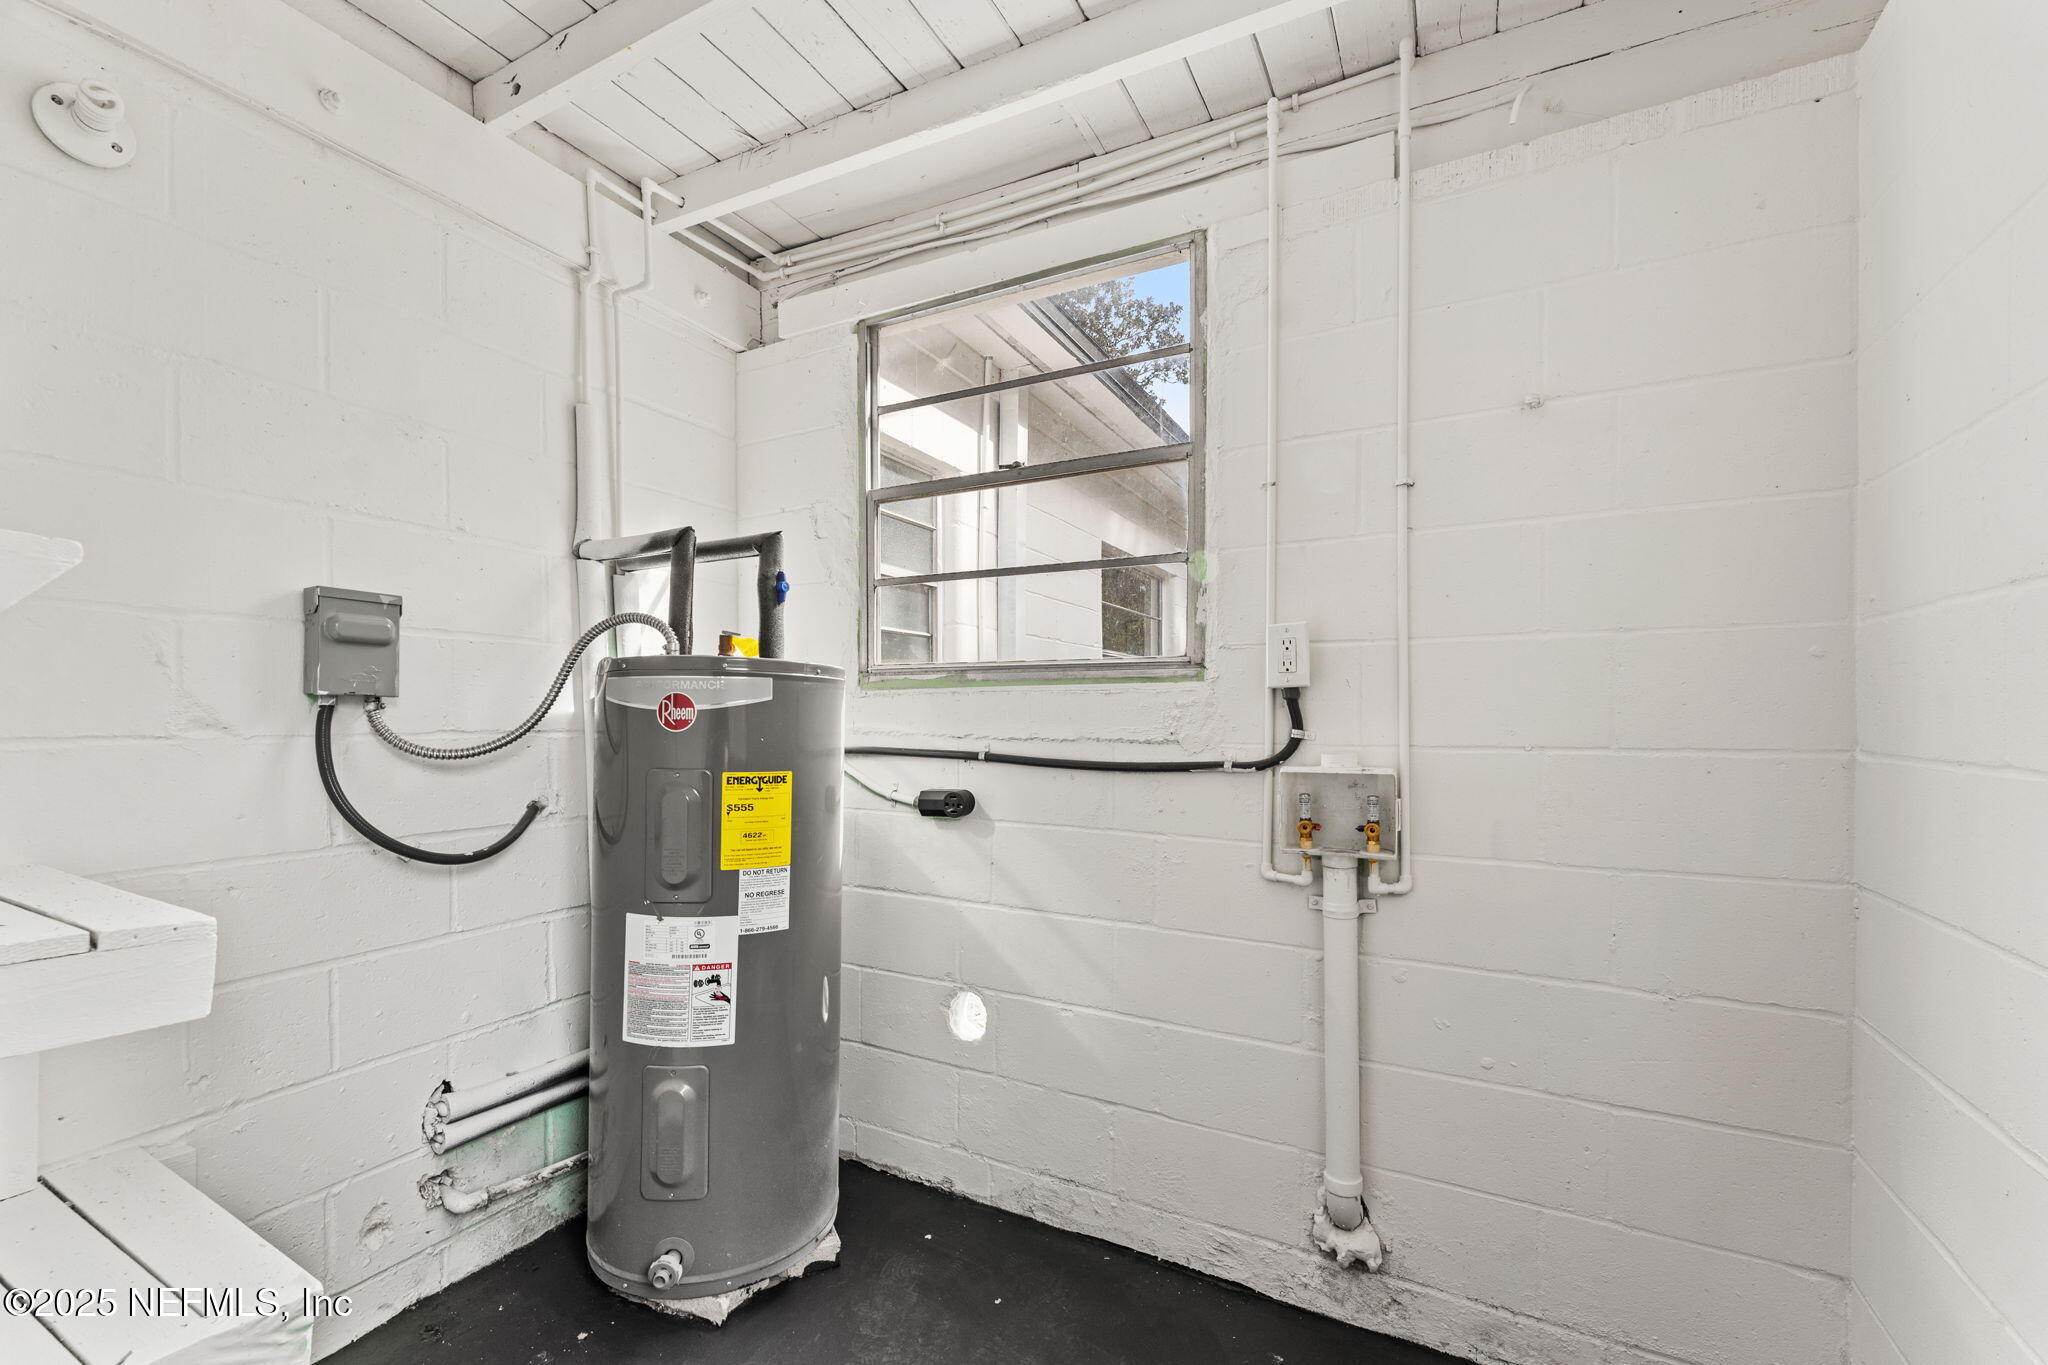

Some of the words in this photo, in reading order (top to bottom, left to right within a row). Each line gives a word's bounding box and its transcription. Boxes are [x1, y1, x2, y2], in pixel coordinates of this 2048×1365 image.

[661, 694, 694, 725] Rheem
[726, 803, 754, 812] $555
[765, 867, 788, 875] RETURN
[755, 889, 785, 898] REGRESE
